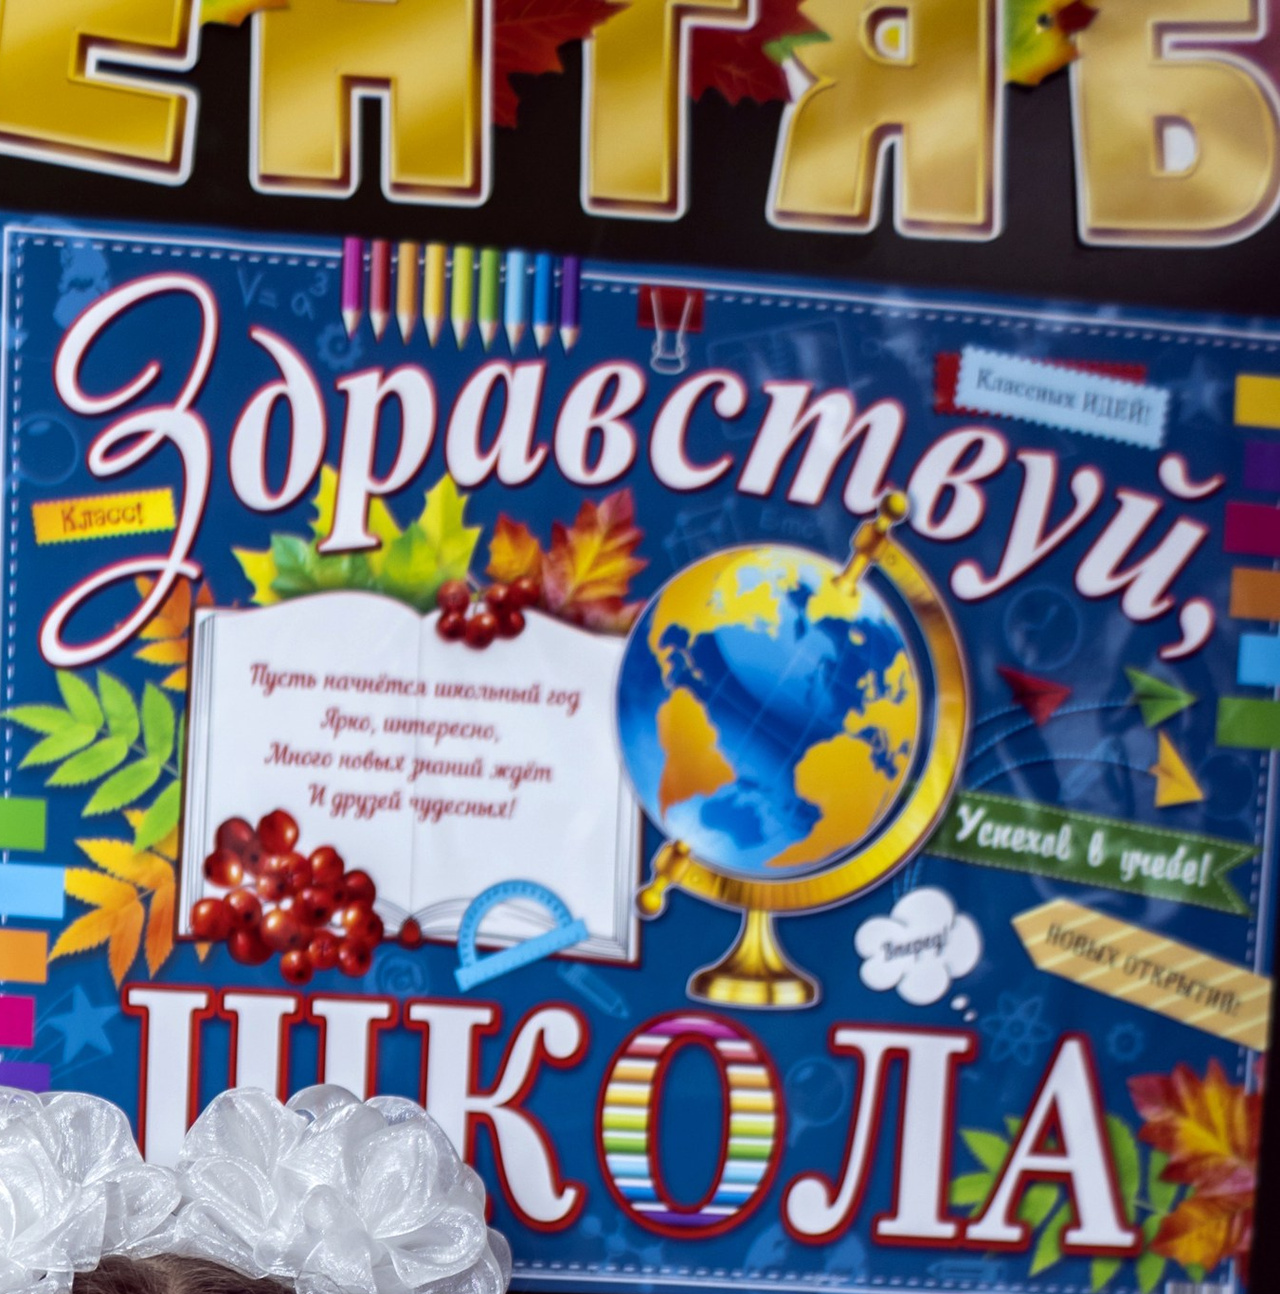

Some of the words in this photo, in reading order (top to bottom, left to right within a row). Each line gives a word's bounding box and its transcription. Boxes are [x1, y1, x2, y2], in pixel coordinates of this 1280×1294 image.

[975, 366, 1077, 411] Классных
[1081, 389, 1152, 428] ИДЕЙ!
[37, 270, 1227, 670] Здравствуй,
[61, 502, 144, 535] Класс!
[249, 661, 318, 698] Пусть
[322, 670, 427, 698] начнётся
[433, 680, 541, 706] школьный
[545, 687, 581, 718] год
[320, 706, 377, 740] Ярко,
[382, 717, 502, 747] интересно,
[263, 741, 334, 771] Много
[337, 748, 405, 773] новых
[407, 754, 484, 783] знаний
[488, 764, 554, 790] ждёт
[307, 783, 327, 808] И
[330, 789, 404, 819] друзей
[408, 797, 518, 823] чудесных!
[955, 803, 1072, 863] Успехов
[1087, 828, 1106, 867] в
[1120, 844, 1214, 888] учебе!
[1045, 922, 1122, 967] НОВЫХ
[1123, 953, 1244, 1018] ОТКРЫТИЙ!
[122, 984, 1140, 1258] ШКОЛА
